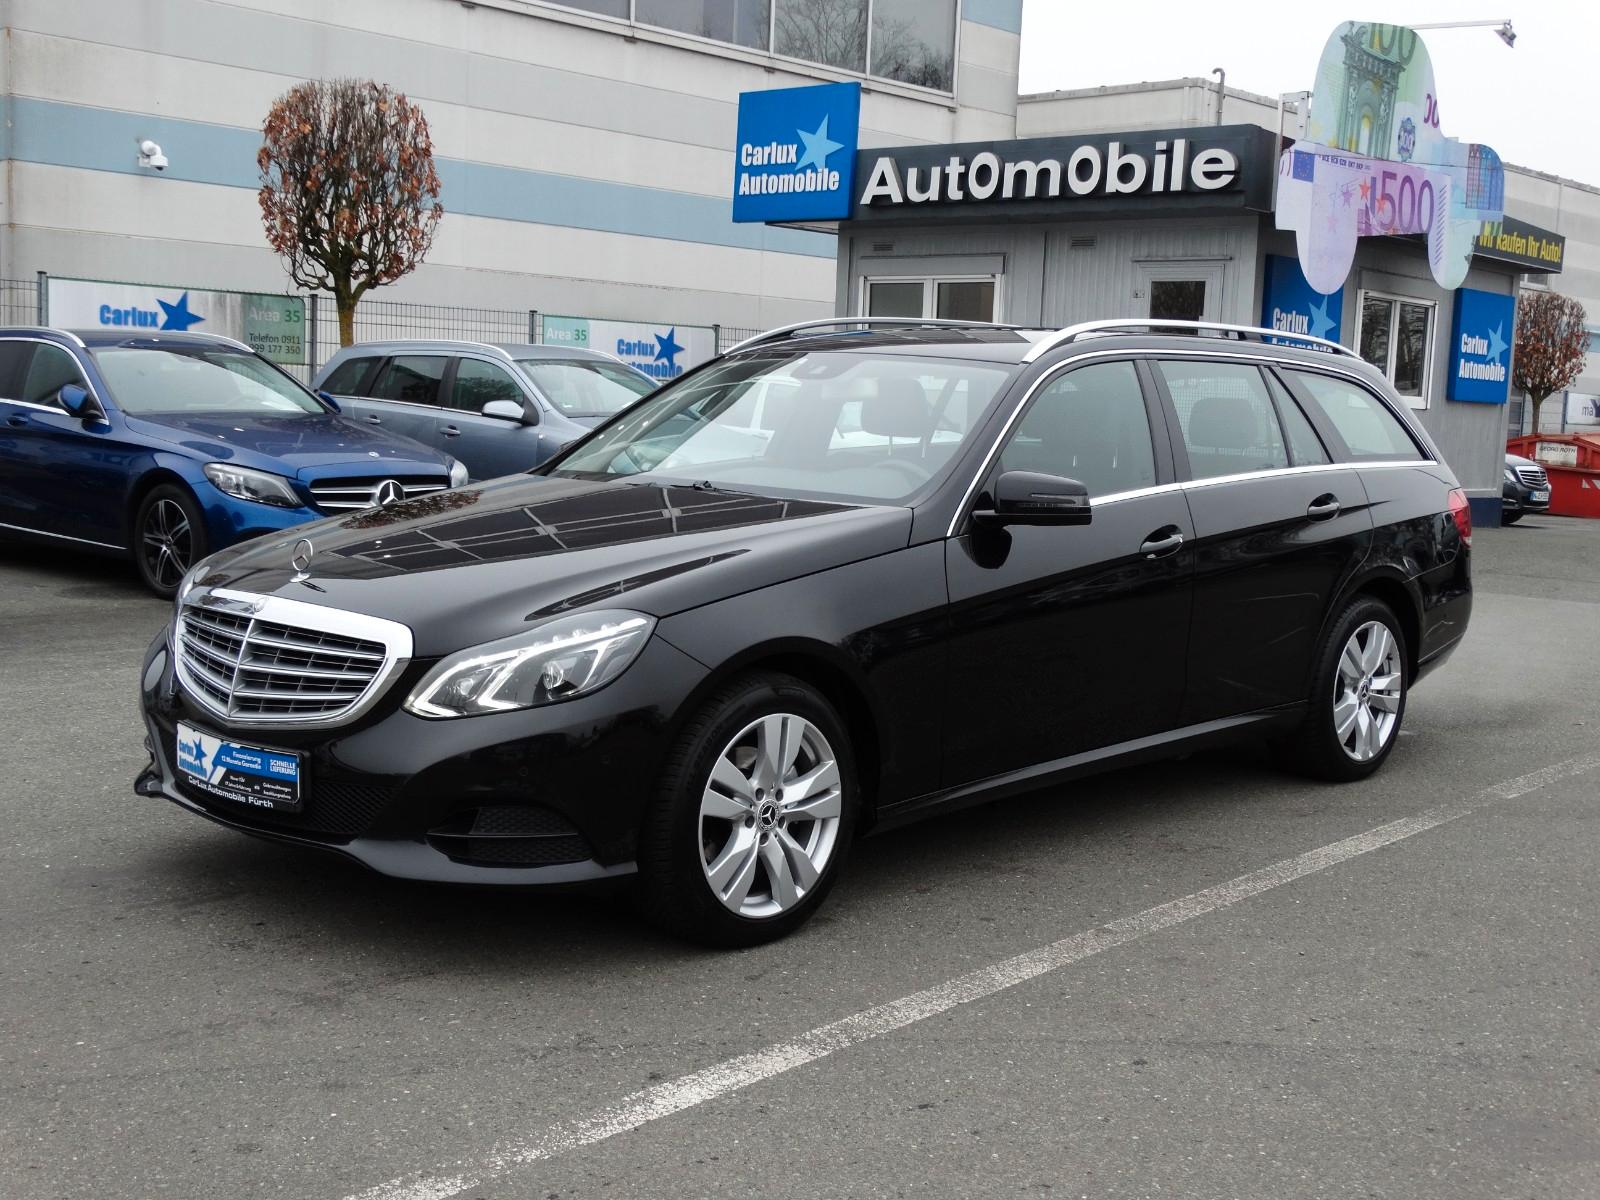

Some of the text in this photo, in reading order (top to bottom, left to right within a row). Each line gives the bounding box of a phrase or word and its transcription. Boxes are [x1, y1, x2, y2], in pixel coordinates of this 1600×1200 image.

[741, 142, 798, 167] Carlux
[739, 168, 840, 196] Automobile
[1496, 231, 1526, 255] kaufen
[1527, 235, 1539, 258] Ihr
[1540, 239, 1562, 263] Auto!
[99, 304, 159, 328] Carlux
[250, 306, 301, 323] Area 35
[1272, 307, 1309, 334] Carlux
[249, 332, 301, 345] Telefon 0911
[545, 327, 587, 341] Area 35
[1461, 333, 1488, 355] Carlux
[268, 345, 282, 354] 177
[285, 345, 301, 355] 350
[616, 338, 656, 357] Carlux
[1458, 358, 1506, 382] Automobile
[207, 784, 247, 803] Automobile
[248, 796, 275, 810] Fürth
